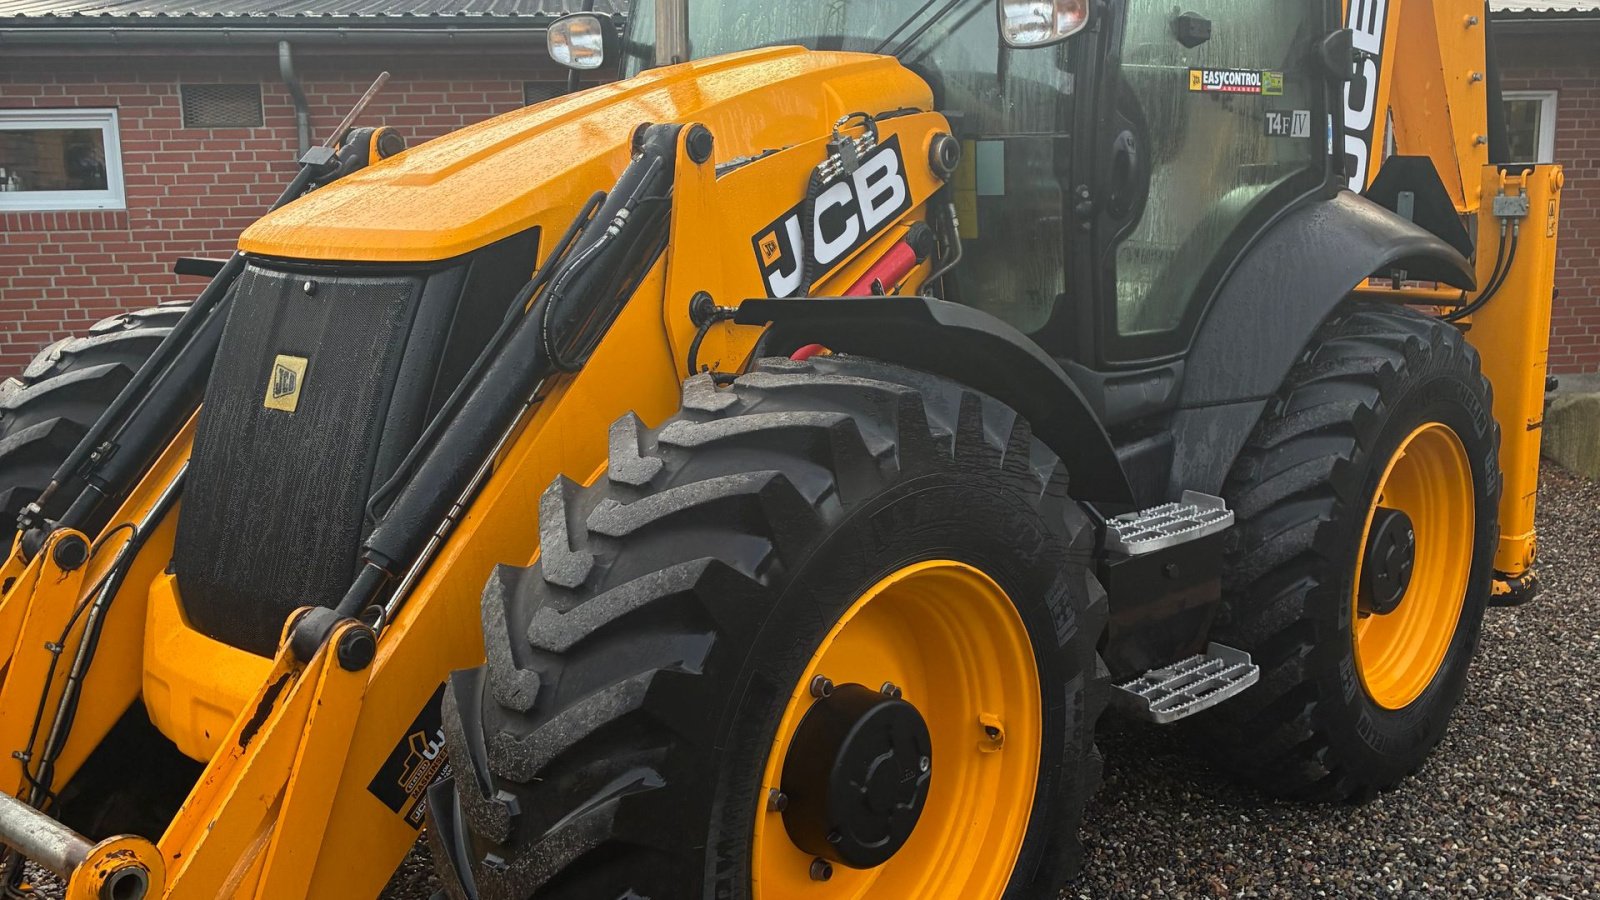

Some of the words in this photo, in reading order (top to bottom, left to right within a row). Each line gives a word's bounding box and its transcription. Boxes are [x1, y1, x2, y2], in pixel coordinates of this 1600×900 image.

[1203, 70, 1261, 89] EASYCONTROL
[768, 148, 906, 298] JCB
[414, 797, 427, 820] JC
